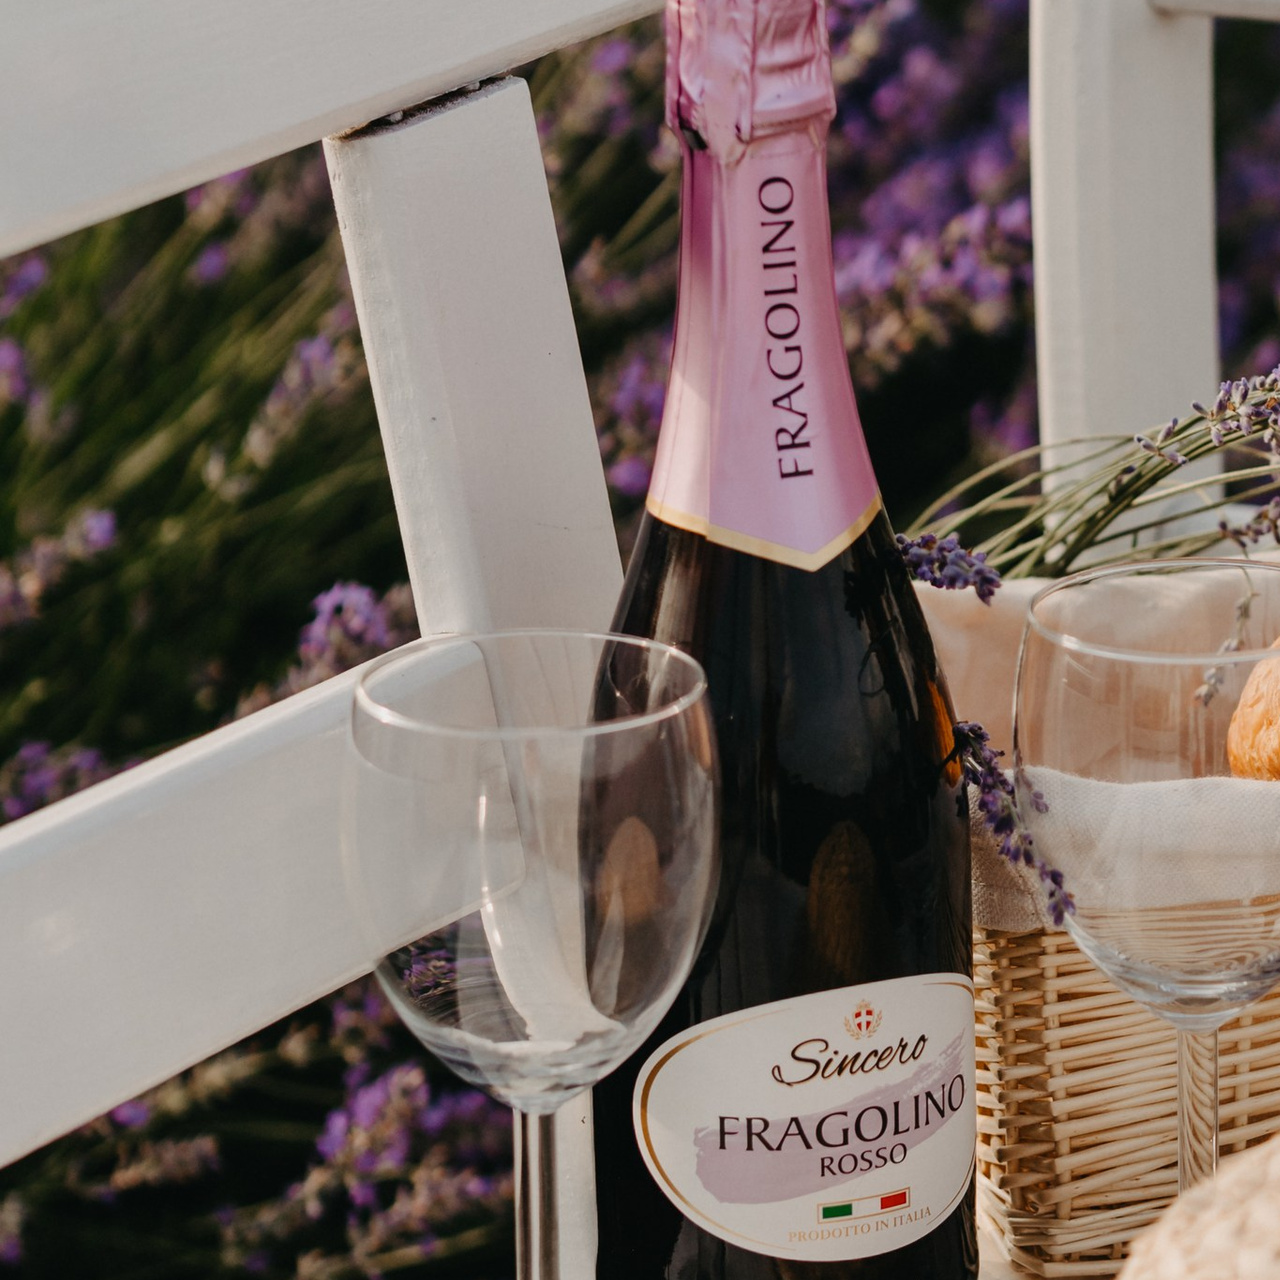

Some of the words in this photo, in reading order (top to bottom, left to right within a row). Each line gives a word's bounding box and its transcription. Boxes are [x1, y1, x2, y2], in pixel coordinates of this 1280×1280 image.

[757, 176, 814, 480] FRAGOLINO
[771, 1033, 929, 1087] Sincero
[718, 1073, 966, 1151] FRAGOLINO
[819, 1142, 908, 1177] ROSSO
[788, 1223, 871, 1243] PRODOTTO
[875, 1218, 890, 1232] IN
[892, 1206, 931, 1227] ITALIA
